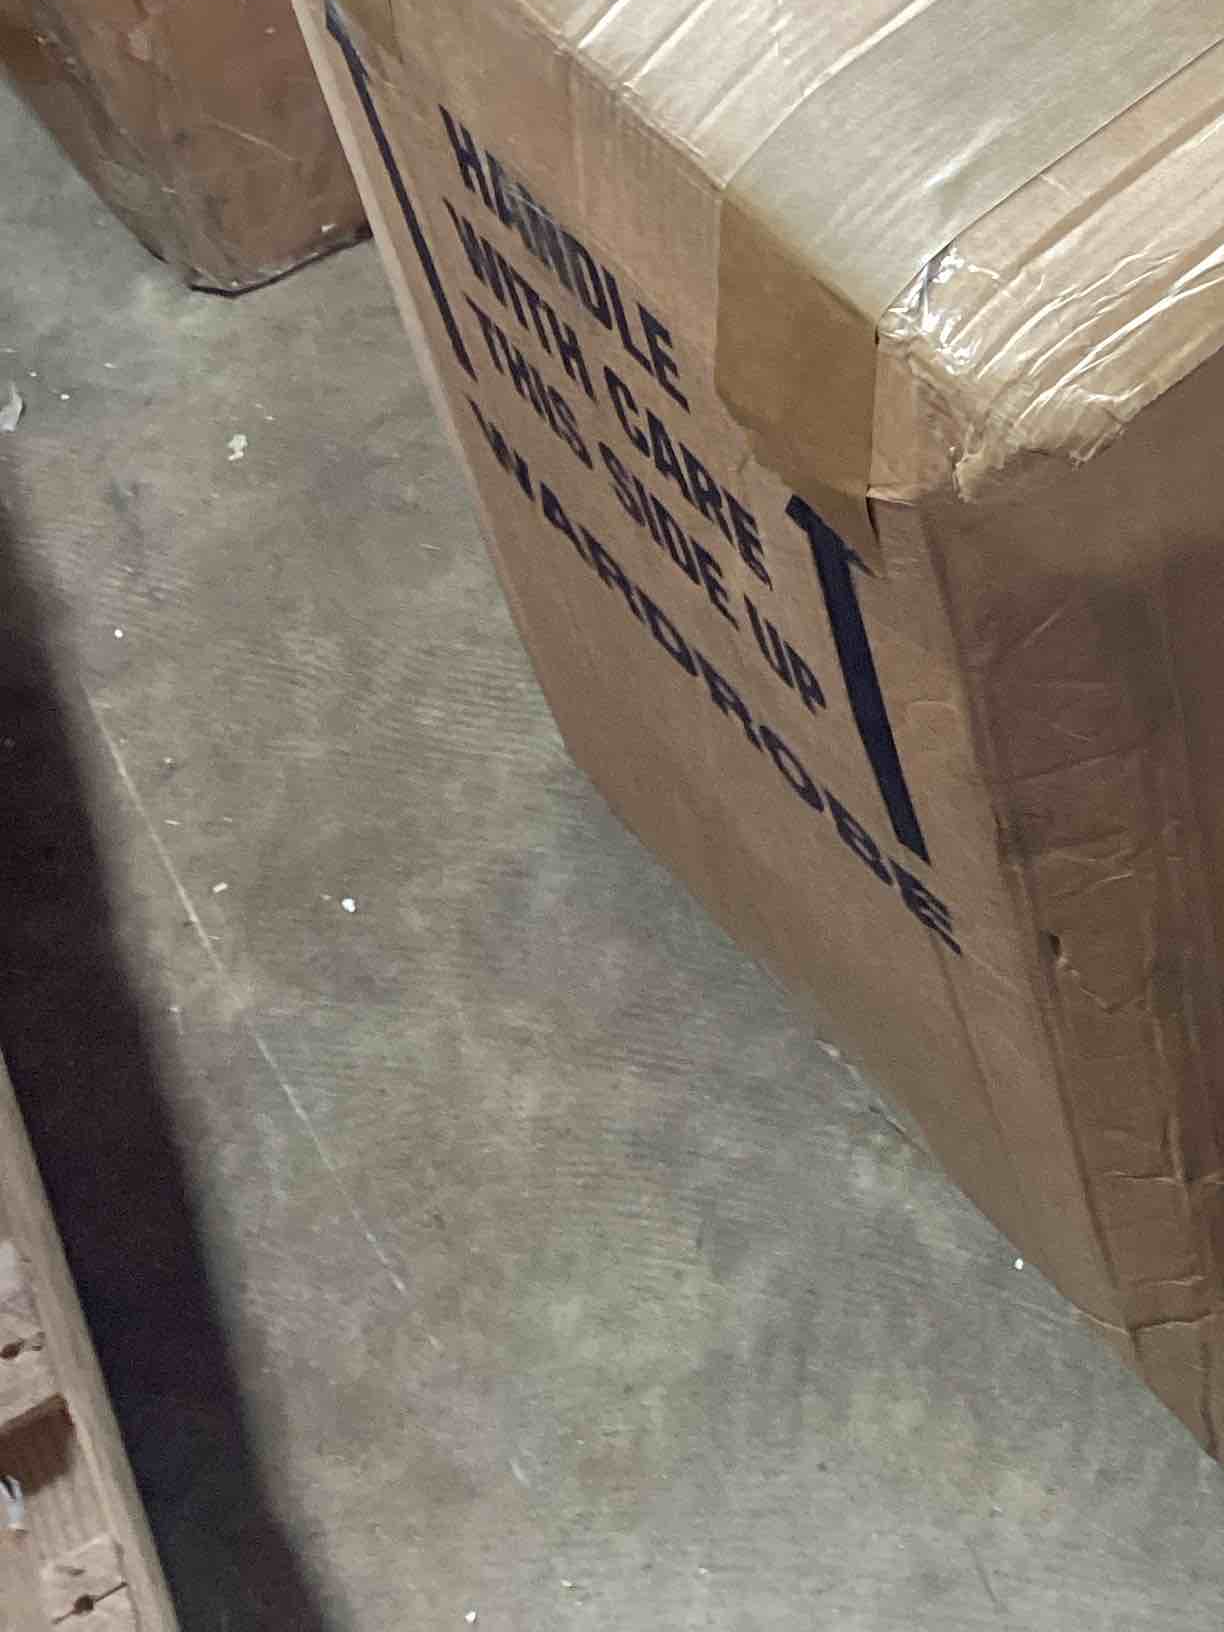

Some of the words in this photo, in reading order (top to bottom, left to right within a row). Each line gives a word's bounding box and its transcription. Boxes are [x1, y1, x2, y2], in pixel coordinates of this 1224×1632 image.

[442, 195, 599, 408] WITH
[602, 364, 773, 591] CARE
[462, 288, 594, 470] THIS
[597, 440, 740, 632] SIDE
[742, 592, 827, 716] UP
[466, 392, 963, 956] WARDROBE
